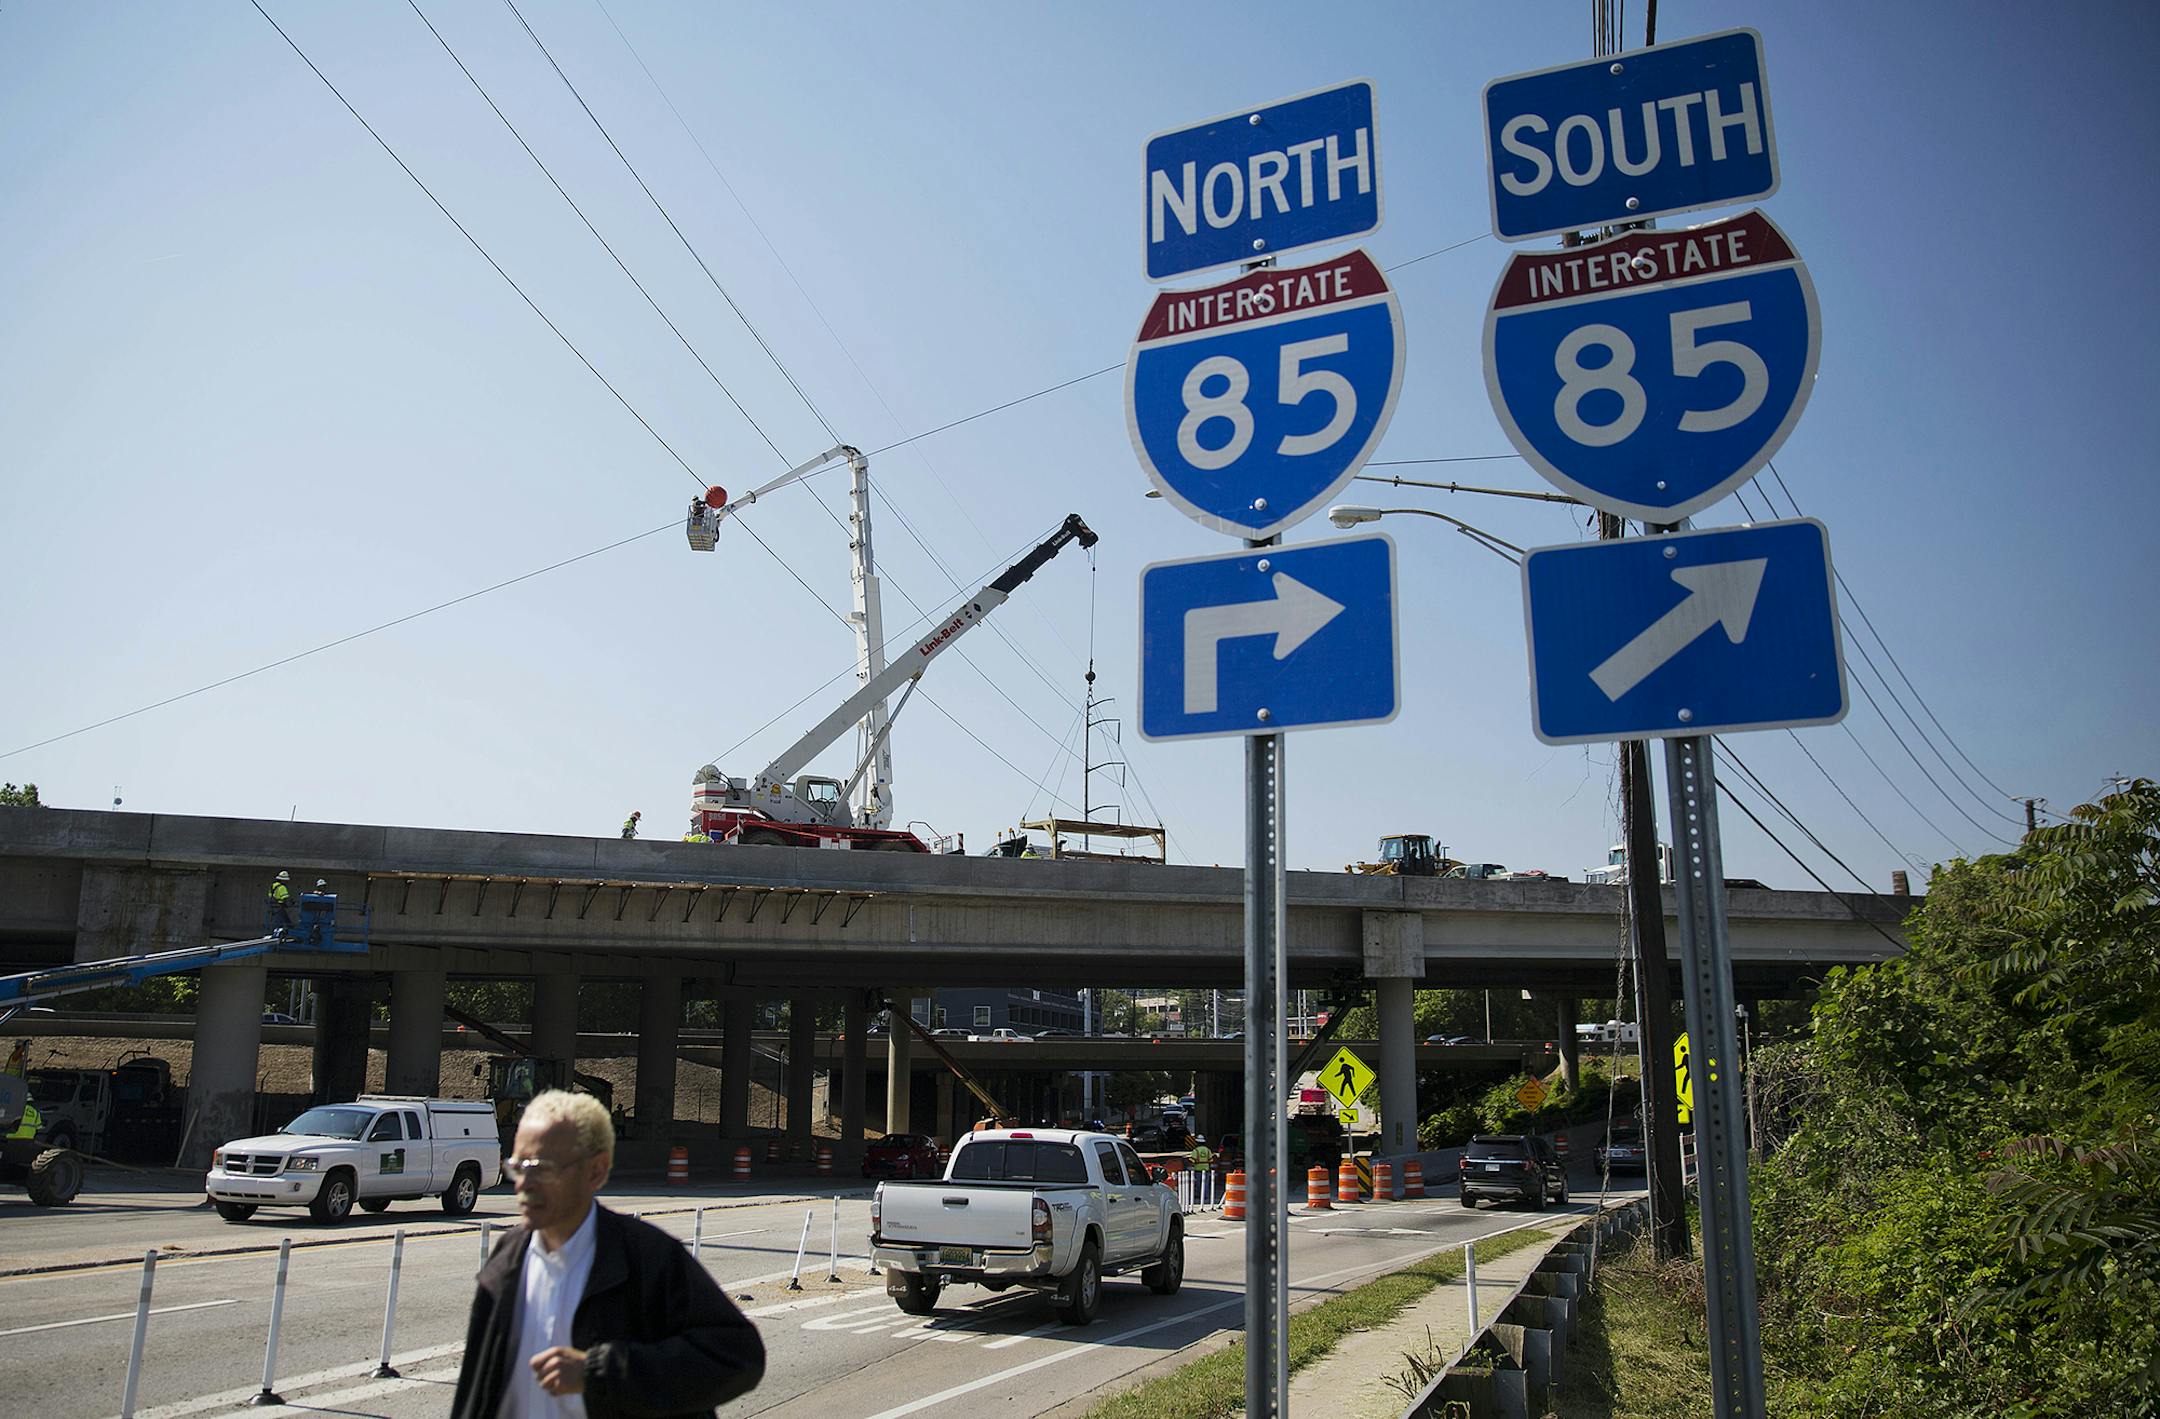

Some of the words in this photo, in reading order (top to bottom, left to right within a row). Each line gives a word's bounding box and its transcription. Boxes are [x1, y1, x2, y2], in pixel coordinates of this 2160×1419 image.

[1151, 127, 1371, 243] NORTH
[1500, 82, 1763, 196] SOUTH
[1168, 266, 1353, 332] INTERSTATE
[1529, 230, 1751, 298] INTERSTATE
[1177, 333, 1357, 470] 85
[1554, 300, 1769, 447] 85
[919, 618, 964, 657] Link-Belt
